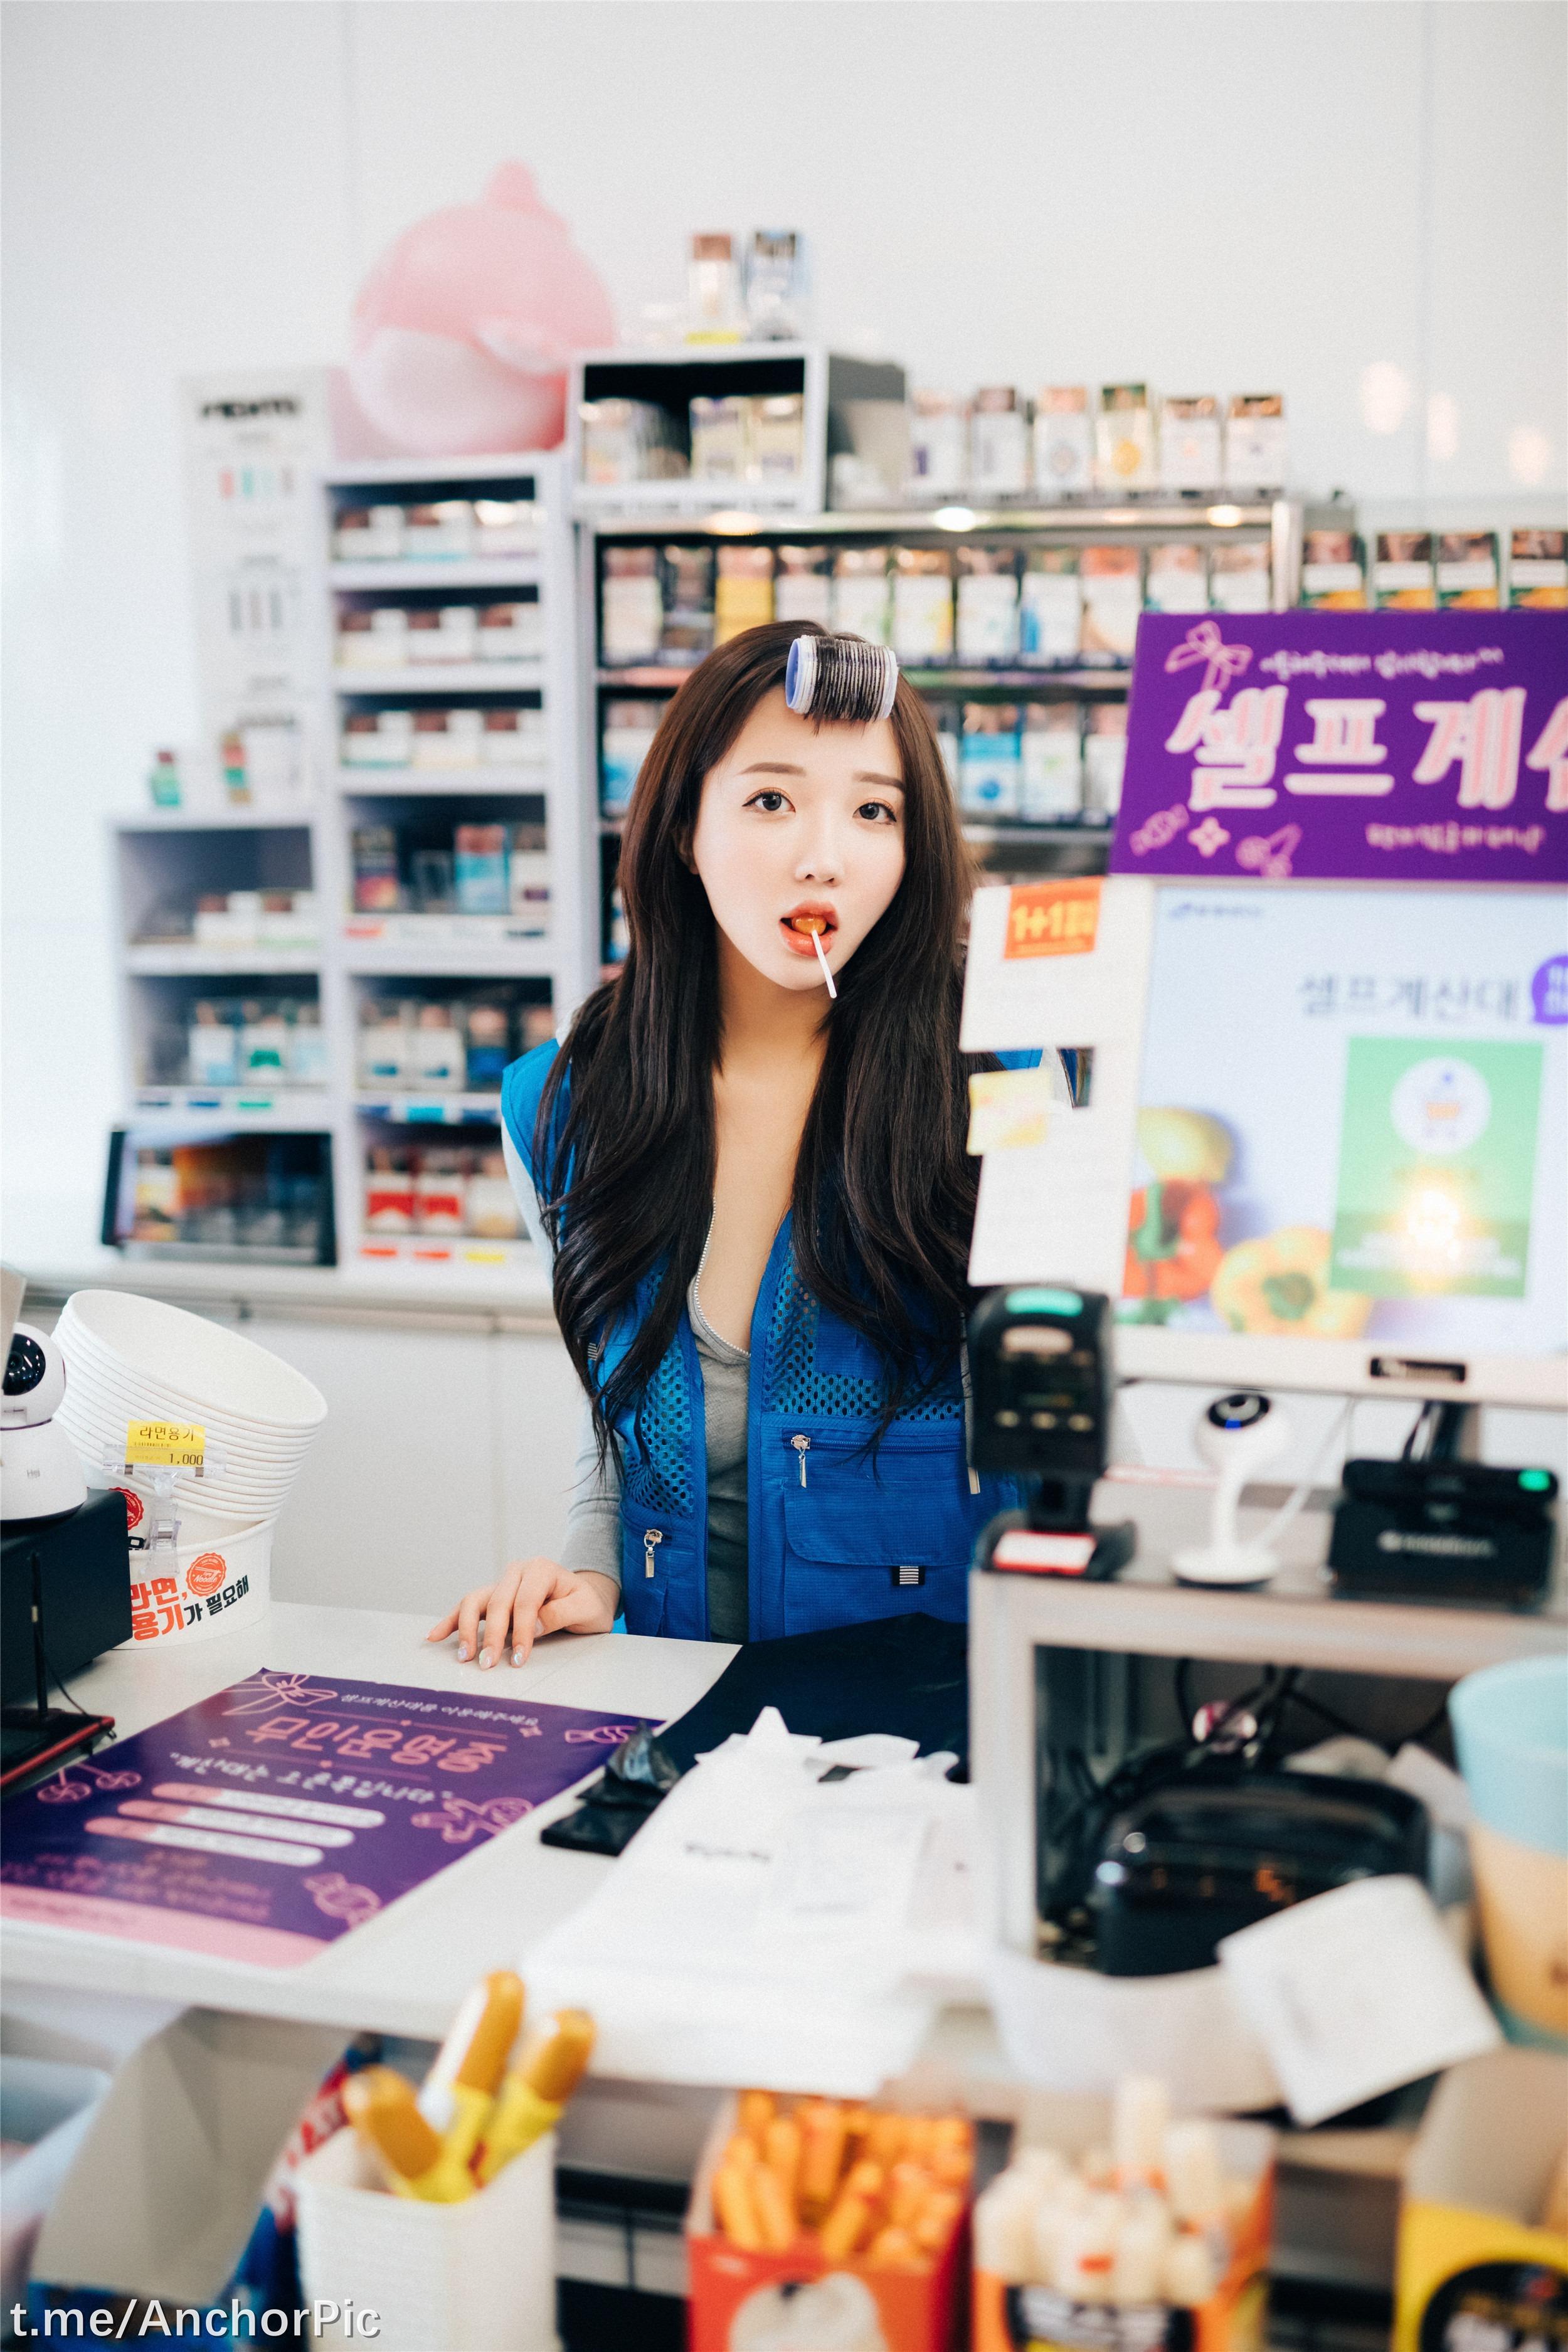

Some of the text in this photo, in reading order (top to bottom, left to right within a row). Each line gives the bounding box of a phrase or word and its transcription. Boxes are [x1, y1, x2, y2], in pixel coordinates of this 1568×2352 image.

[139, 1425, 194, 1441] 라면용기
[169, 1453, 204, 1466] 1,000
[131, 1574, 249, 1641] 용기가 필요해
[245, 1717, 507, 1773] 무인운영중
